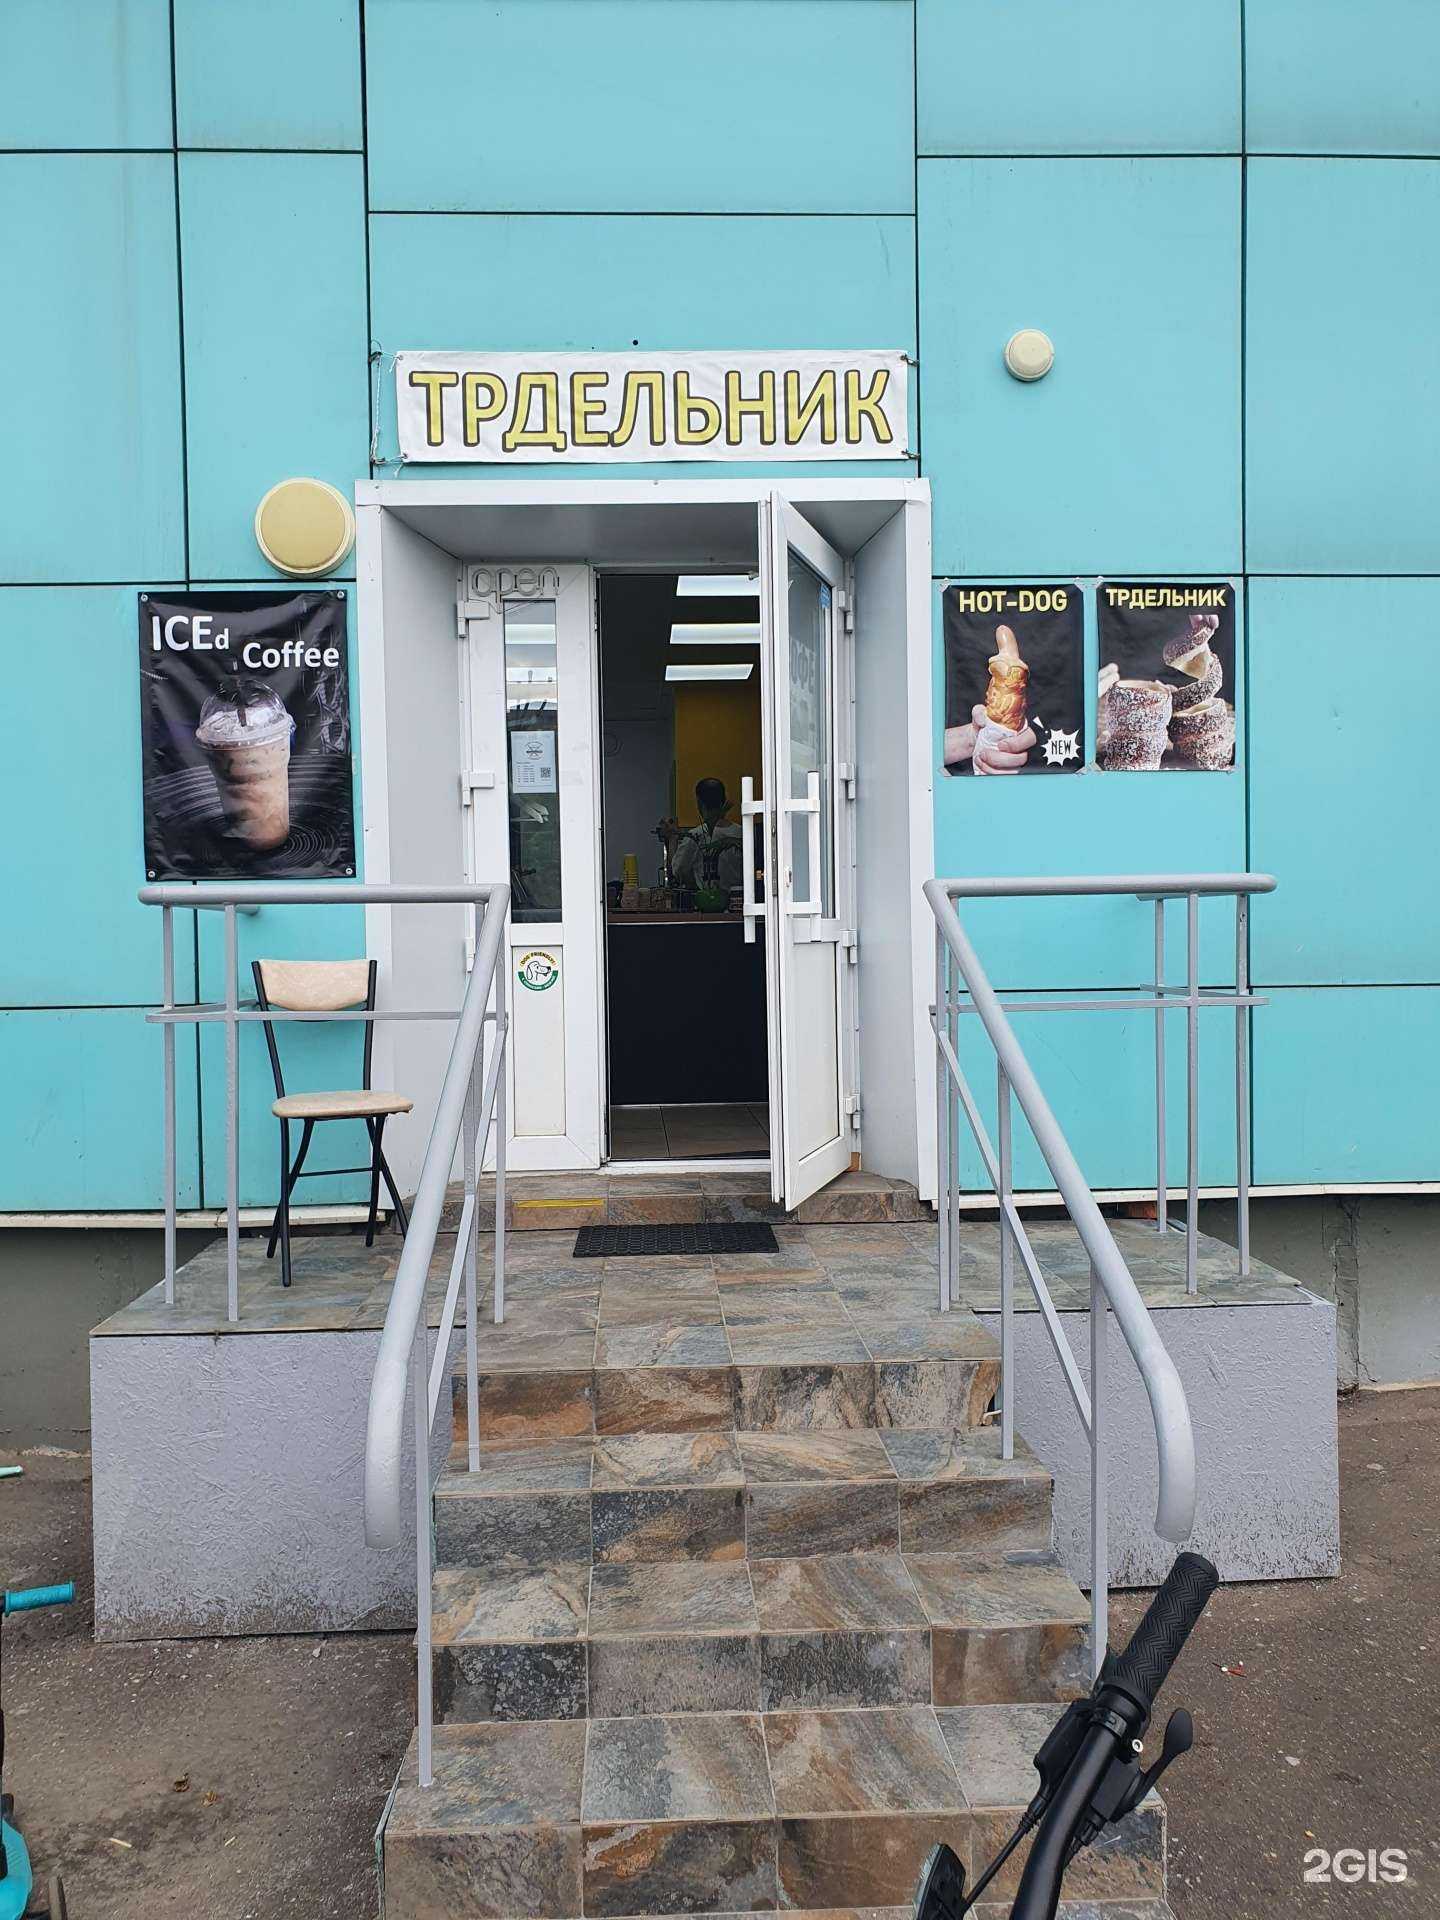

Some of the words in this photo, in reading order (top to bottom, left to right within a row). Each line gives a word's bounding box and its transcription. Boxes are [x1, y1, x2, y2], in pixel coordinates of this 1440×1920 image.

[409, 369, 894, 452] ТРДЕЛЬНИК
[472, 566, 560, 610] open
[959, 590, 1068, 613] HOT-DOG
[1106, 588, 1227, 610] ТРДЕЛЬНИК
[152, 615, 230, 651] ICEd
[242, 640, 339, 669] Coffee
[1051, 739, 1072, 755] NEW
